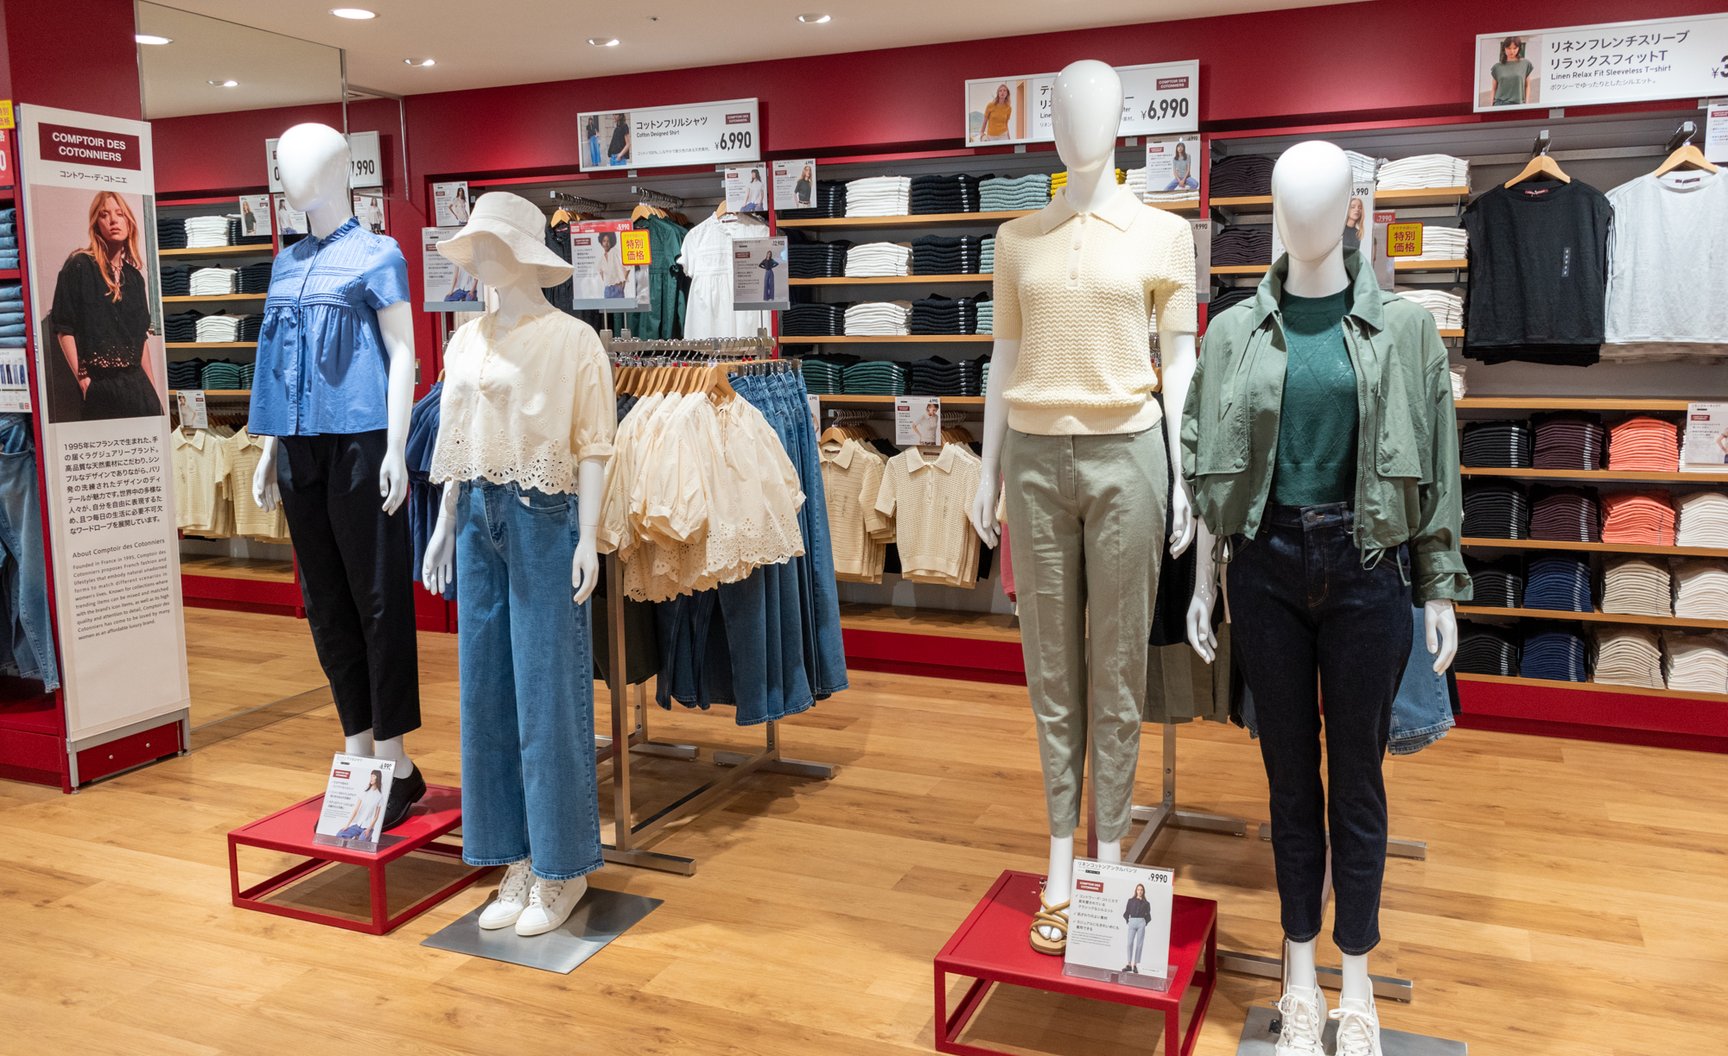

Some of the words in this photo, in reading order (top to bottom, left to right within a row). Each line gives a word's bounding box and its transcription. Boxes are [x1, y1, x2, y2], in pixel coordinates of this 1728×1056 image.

[1552, 30, 1690, 54] リネンフレンチスリーブ
[1551, 50, 1668, 70] リラックスフィットT
[1606, 67, 1642, 76] Sleeveless
[1040, 85, 1052, 96] テ
[1140, 98, 1188, 120] ¥6,990
[636, 116, 708, 130] コットンフリルシャツ
[52, 132, 105, 148] COMPTOIR
[107, 139, 126, 150] DES
[651, 130, 668, 138] Designed
[714, 131, 752, 150] ¥6,990
[58, 146, 122, 162] COTONNIERS
[60, 170, 128, 184] コントワー・デ・コトニエ
[1394, 231, 1416, 241] 特別
[626, 238, 644, 249] 特別
[1394, 242, 1415, 252] 価格
[627, 250, 644, 260] 価格
[64, 436, 158, 450] 1995年にフランスで生まれた、手
[93, 546, 121, 554] Comptoir
[134, 539, 165, 548] Cotonniers
